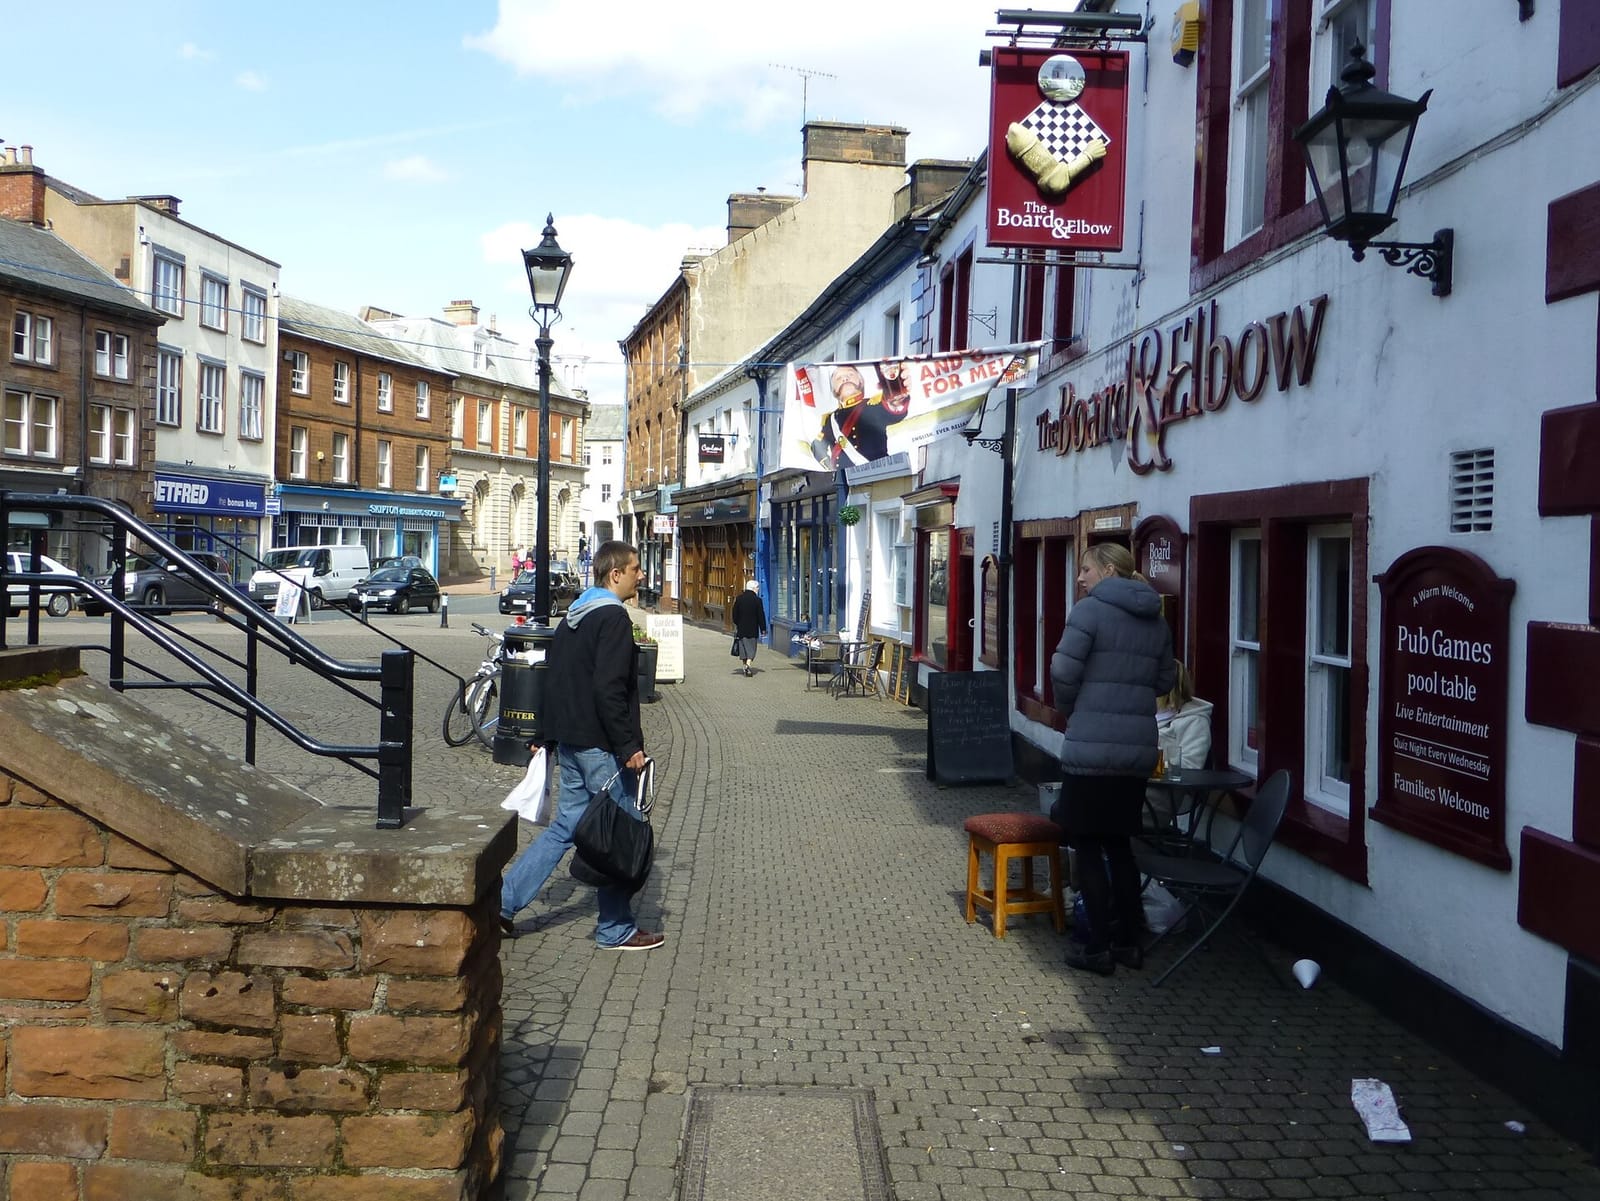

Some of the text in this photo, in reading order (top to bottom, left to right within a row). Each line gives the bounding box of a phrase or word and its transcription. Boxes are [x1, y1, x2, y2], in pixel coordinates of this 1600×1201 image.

[1024, 201, 1047, 213] The
[997, 208, 1112, 239] Board & Elbow
[920, 356, 964, 381] AND
[922, 358, 1005, 398] FOR ME!
[1036, 408, 1059, 452] The
[1056, 342, 1136, 457] Board
[1161, 294, 1329, 424] Elbow
[935, 426, 950, 436] EVER
[227, 498, 244, 507] bonus
[246, 499, 258, 510] king
[369, 504, 399, 515] SKIPTON
[1149, 541, 1171, 560] Board
[1412, 585, 1475, 612] A Warm Welcome
[1397, 625, 1492, 664] Pub Games
[1407, 671, 1477, 702] pool table
[503, 710, 535, 720] LITTER
[1395, 702, 1490, 739] Live Entertainment
[1393, 737, 1490, 776] Quiz Night Every Wednesday
[1393, 772, 1490, 820] Families Welcome
